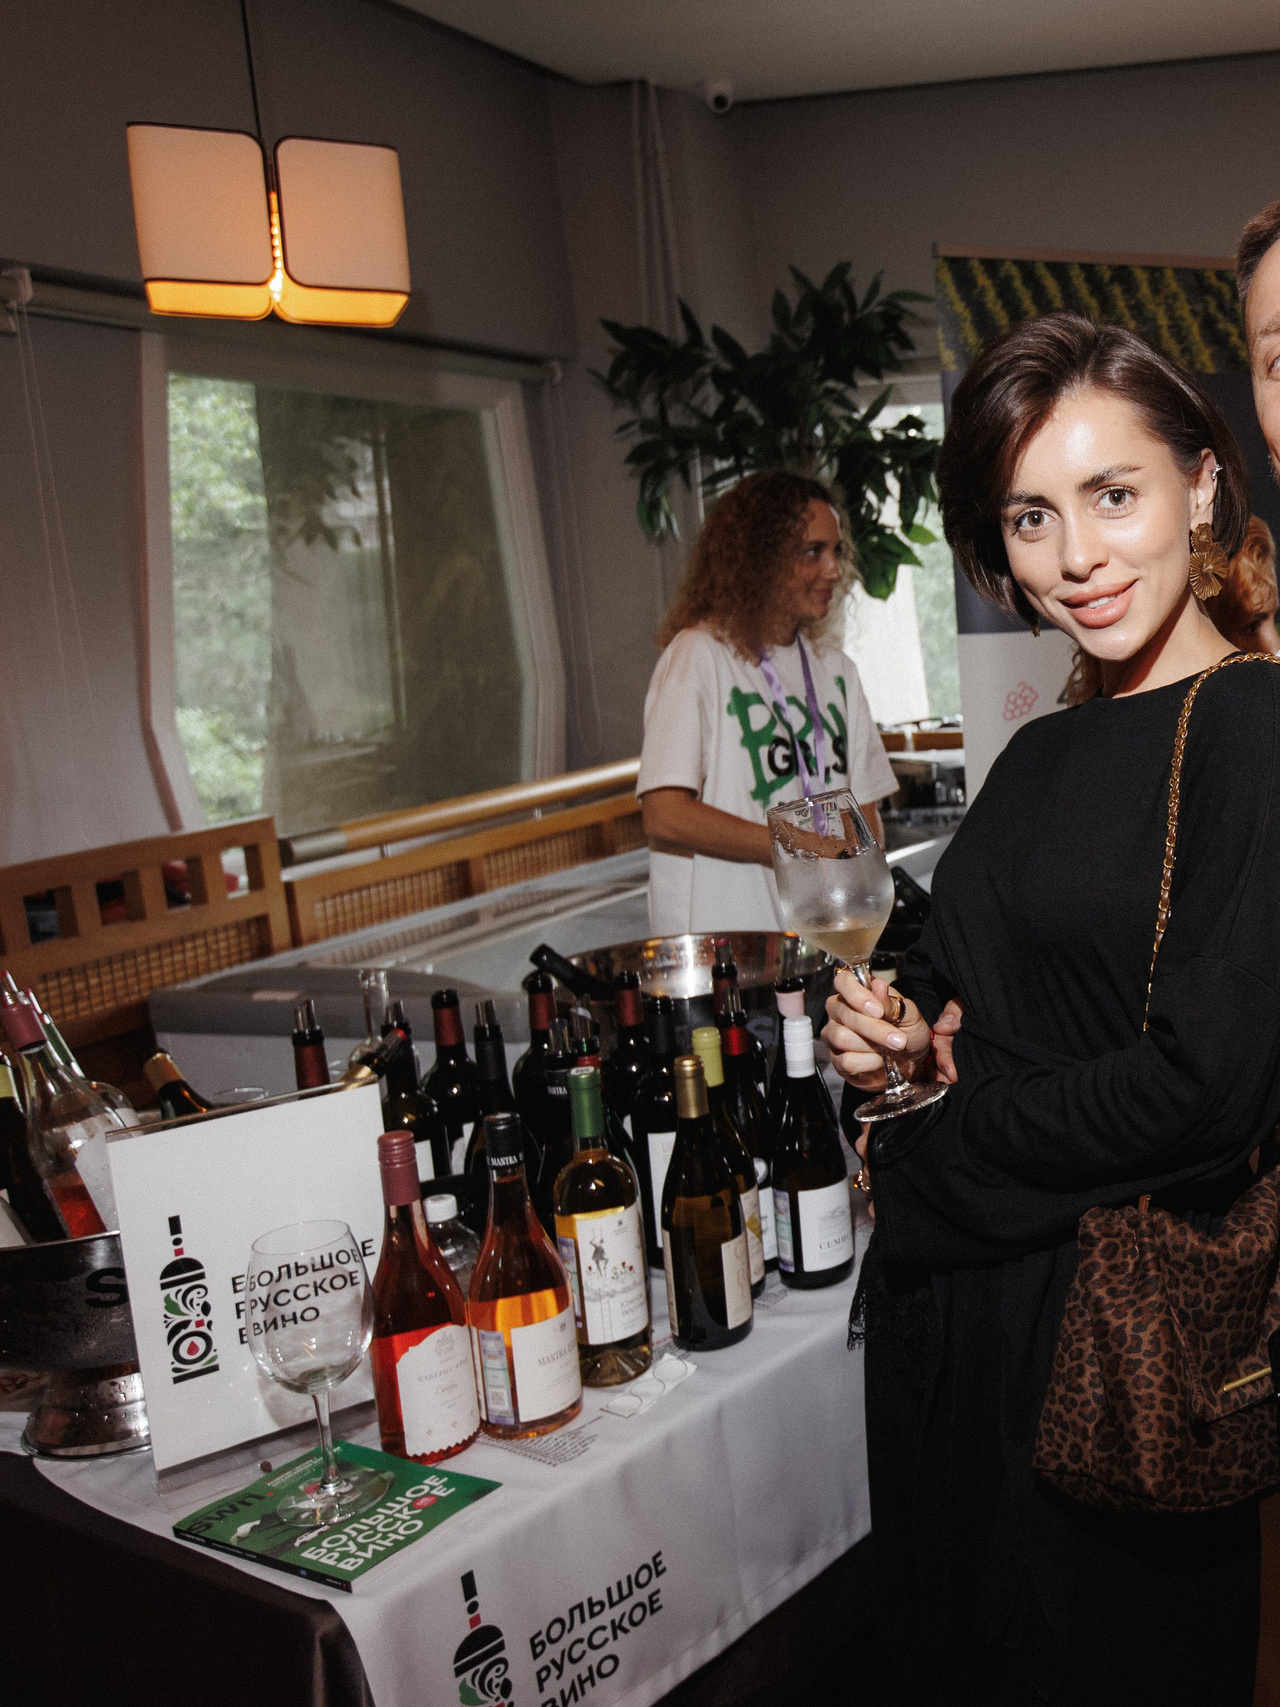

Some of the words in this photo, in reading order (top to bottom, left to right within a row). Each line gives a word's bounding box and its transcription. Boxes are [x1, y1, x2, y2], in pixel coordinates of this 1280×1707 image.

[300, 1474, 449, 1561] БОЛЬШОЕ
[336, 1518, 424, 1572] ВИНО
[529, 1550, 667, 1661] БОЛЬШОЕ
[535, 1588, 663, 1694] РУССКОЕ
